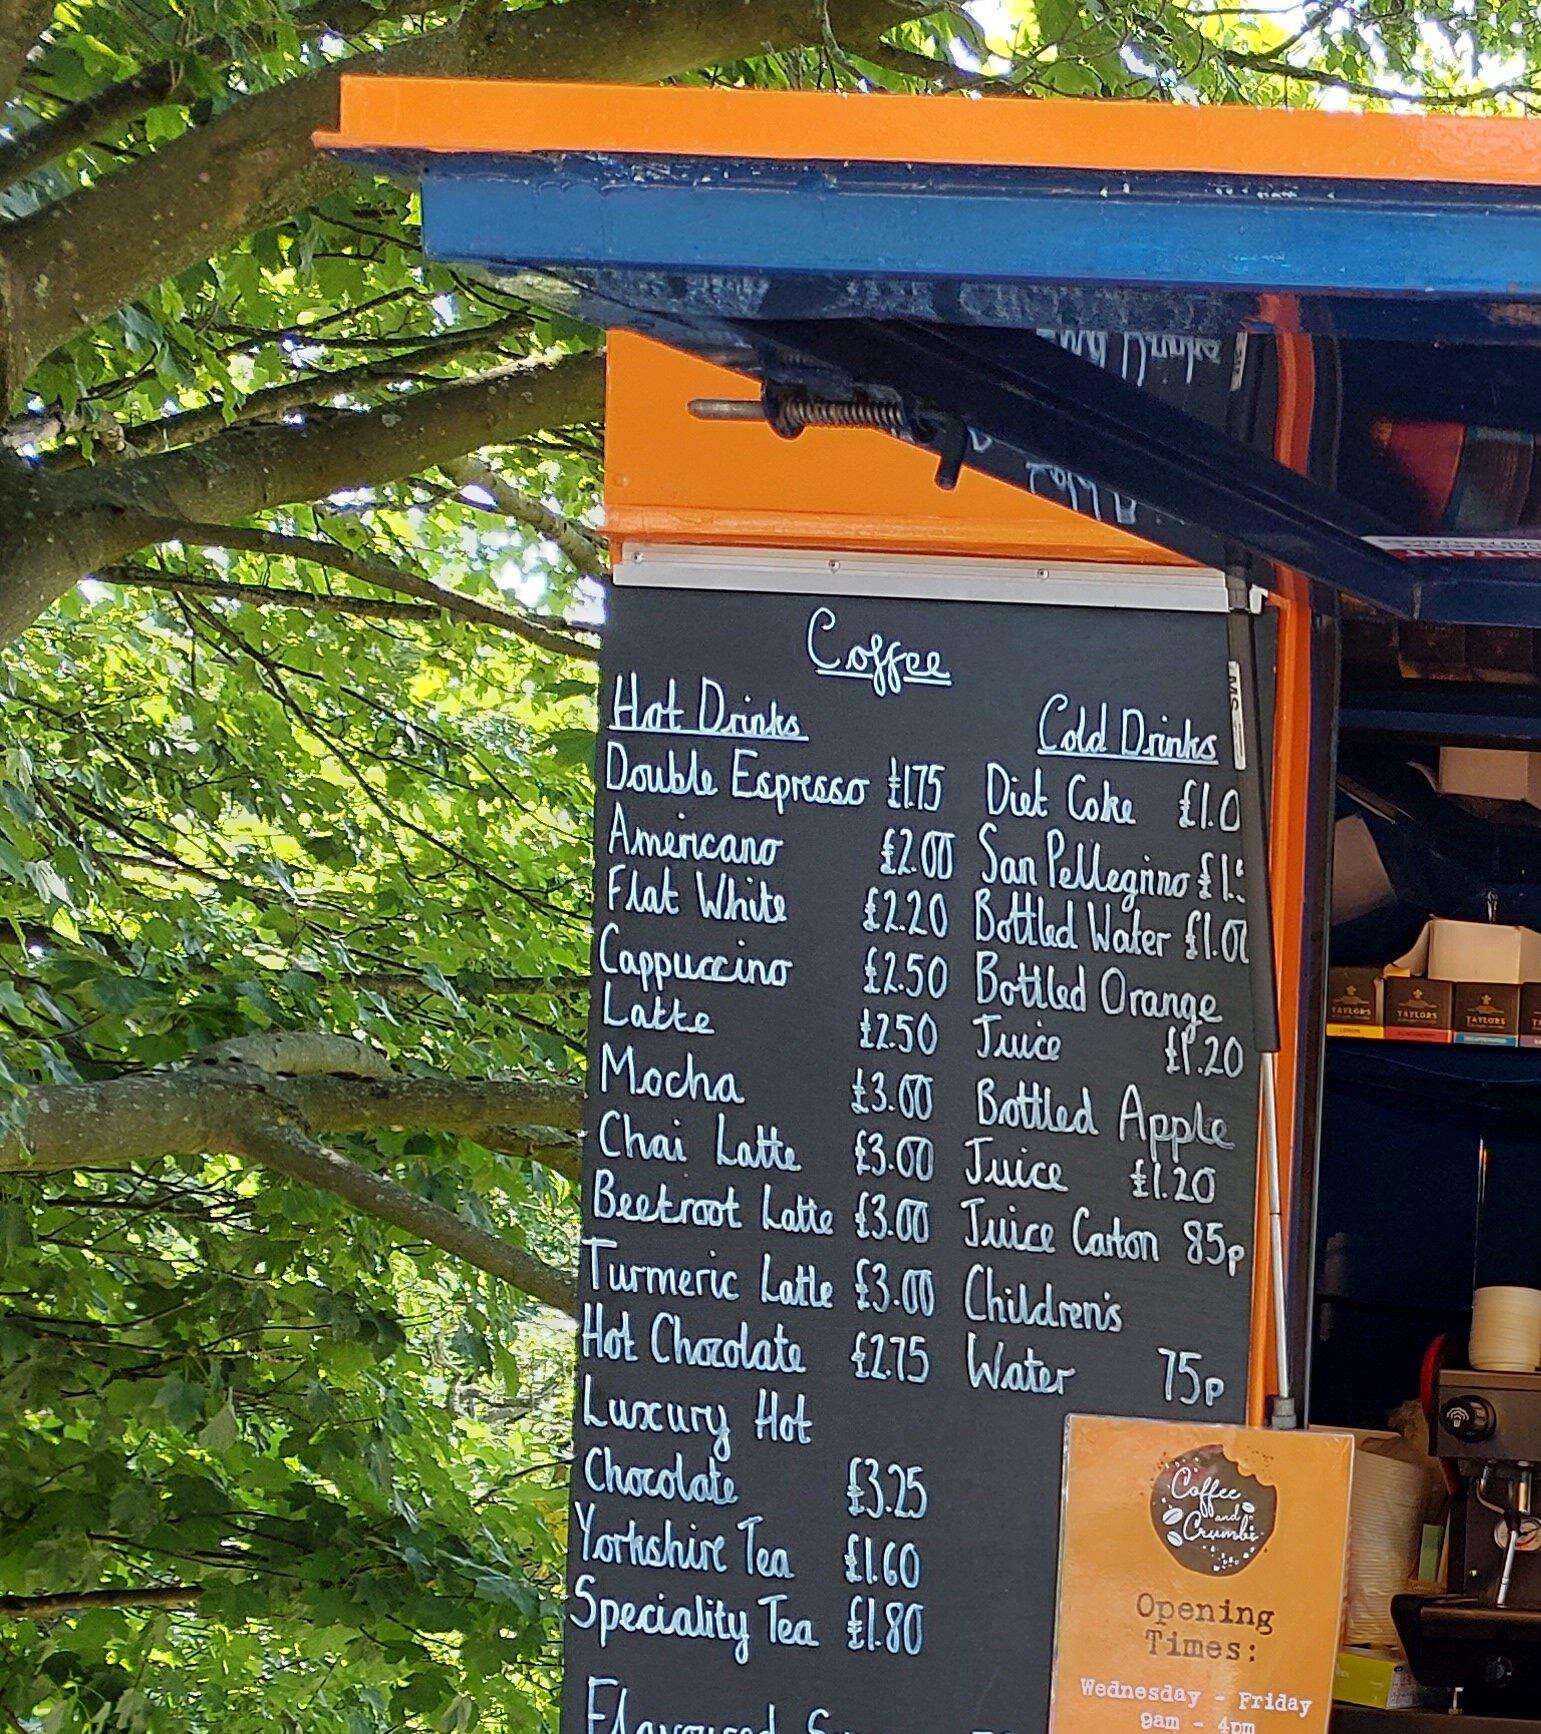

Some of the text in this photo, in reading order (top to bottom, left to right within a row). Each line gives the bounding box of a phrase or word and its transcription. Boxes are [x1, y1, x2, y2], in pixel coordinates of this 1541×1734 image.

[808, 607, 951, 696] Coffee
[609, 672, 801, 741] Hot Drinks
[1038, 694, 1218, 764] Cold Drinks
[607, 741, 718, 795] Double
[733, 749, 870, 814] Espresso
[988, 763, 1135, 824] Diet Coke
[609, 802, 955, 879] Americano £2.00
[979, 823, 1190, 912] San Pellegrino
[609, 864, 947, 937] Flat White £2.20
[976, 898, 1171, 956] Bottled Water
[600, 923, 947, 998] Cappuccino £2.50
[604, 981, 937, 1054] Latte £2.50
[600, 1111, 933, 1180] Chai Latte £3.00
[961, 1198, 1244, 1276] Juice Carton 85p
[582, 1303, 637, 1360] Hot
[652, 1304, 806, 1372] Chocolate
[968, 1333, 1223, 1405] Water 75p
[575, 1502, 919, 1587] Yorkshire Tea £1.60
[1136, 1592, 1275, 1635] Opening
[1146, 1629, 1257, 1662] Times:
[1080, 1677, 1312, 1717] Wednesday Friday
[1141, 1711, 1179, 1731] 9am
